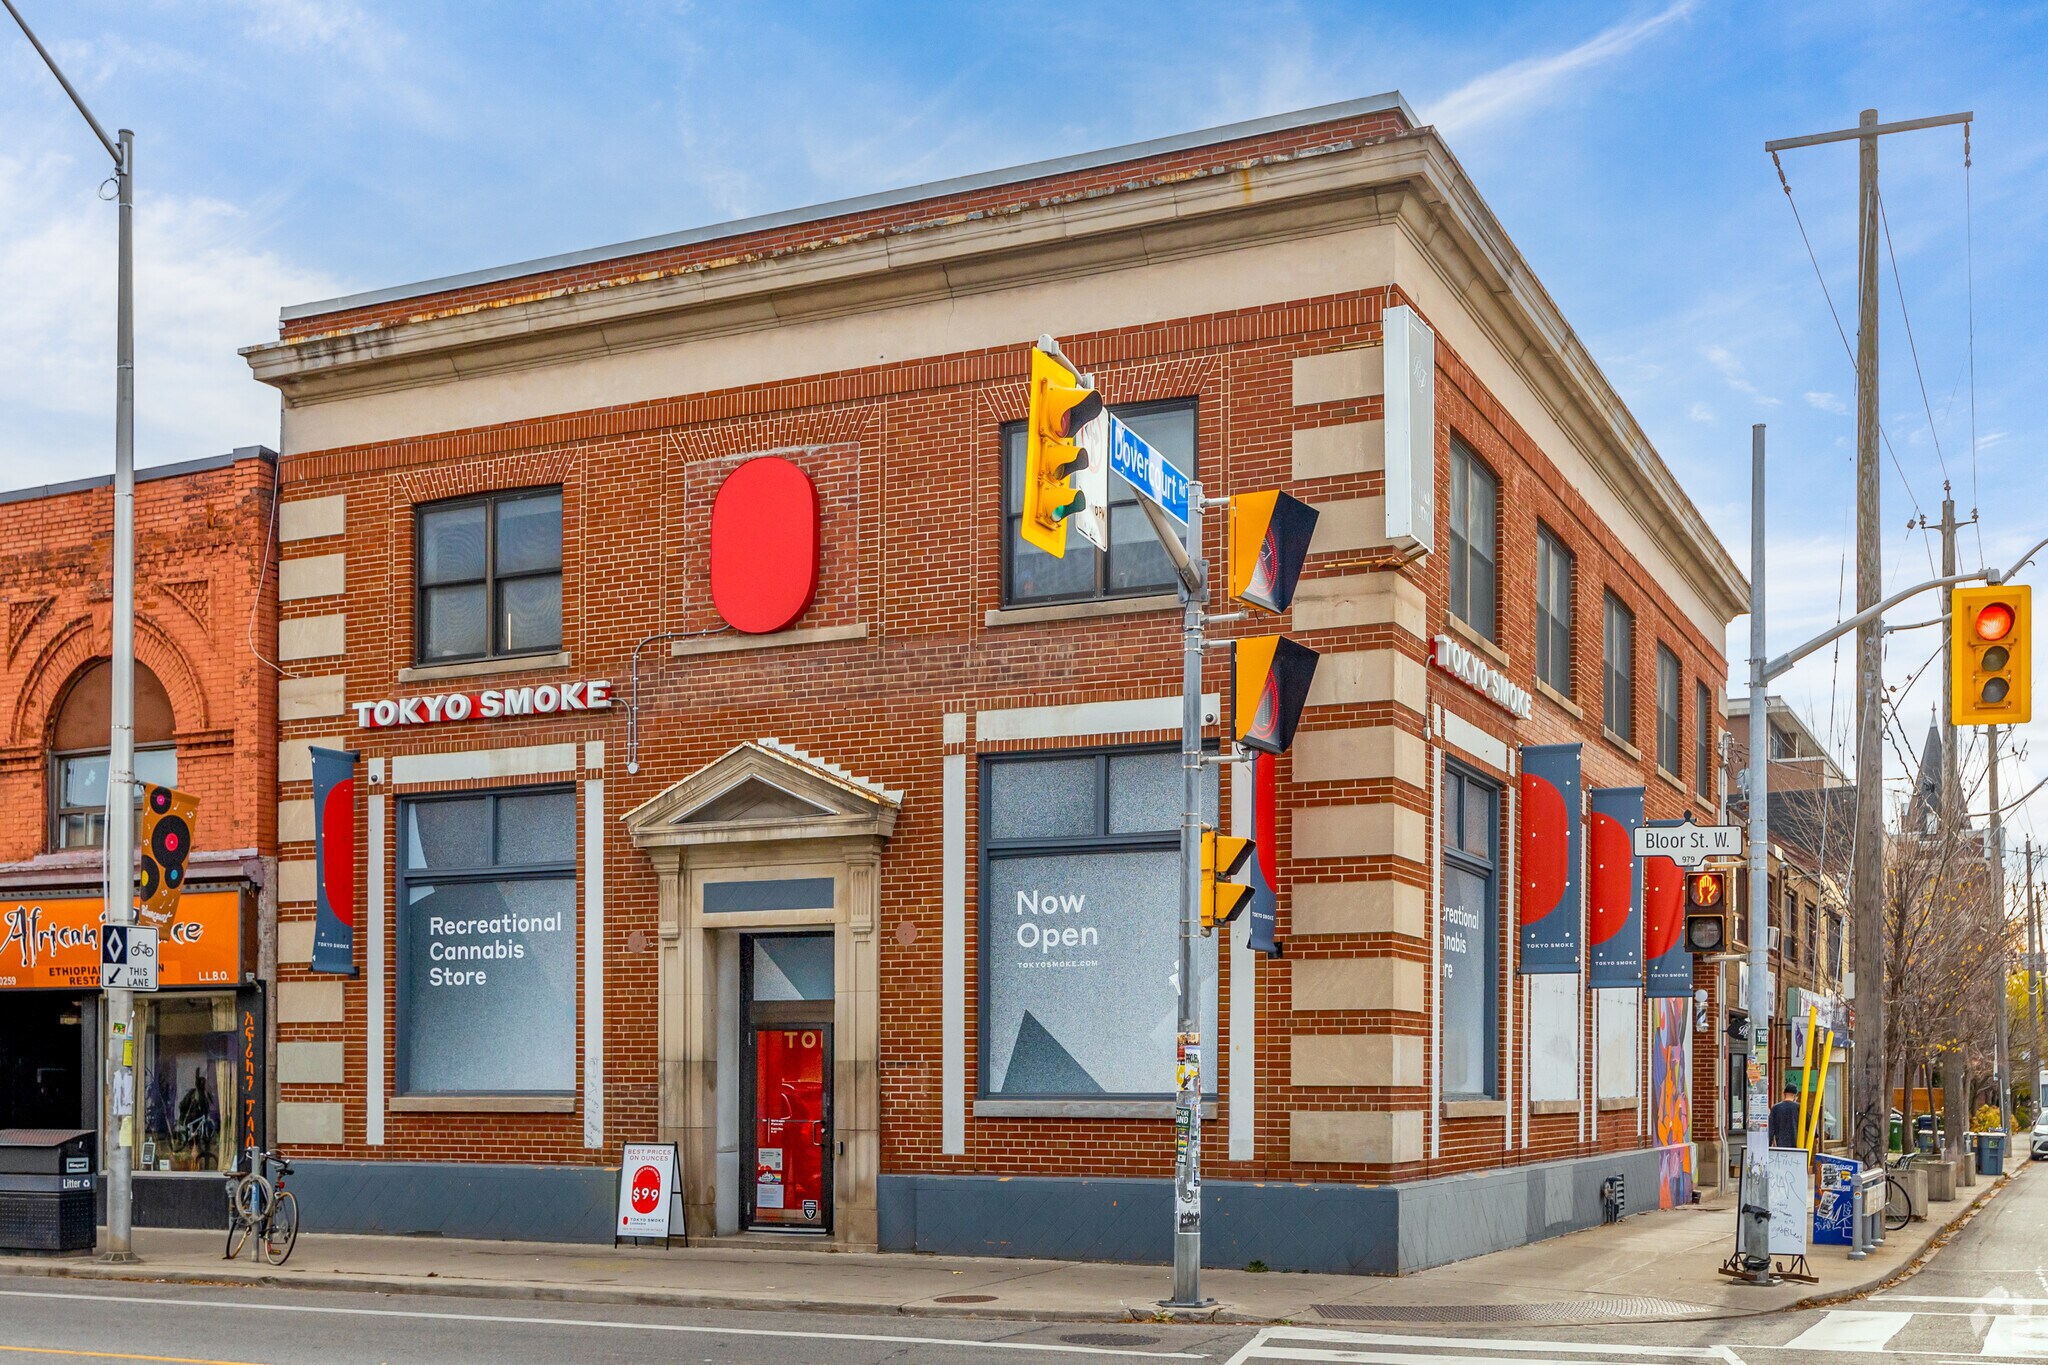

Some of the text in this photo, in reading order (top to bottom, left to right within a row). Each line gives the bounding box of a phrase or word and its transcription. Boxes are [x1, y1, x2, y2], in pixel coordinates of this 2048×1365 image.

[1115, 425, 1187, 505] Dovercourt Rd
[1434, 634, 1533, 721] TOKYO SMOKE
[352, 680, 612, 728] TOKYO SMOKE
[1645, 832, 1730, 849] Bloor St. W.
[1681, 855, 1696, 863] 979
[1017, 890, 1086, 915] Now
[430, 911, 562, 936] Recreational
[1443, 905, 1479, 930] reational
[0, 905, 98, 968] African
[1017, 922, 1098, 954] Open
[429, 939, 525, 961] Cannabis
[49, 966, 101, 976] ETHIOPIA
[129, 967, 148, 976] THIS
[1017, 960, 1098, 969] TOKYOSMOKE.COM
[127, 978, 149, 987] LANE
[198, 971, 230, 981] L.L.B.O.
[429, 967, 487, 987] Store
[784, 1031, 823, 1049] TO
[63, 1178, 81, 1189] Litter
[632, 1187, 659, 1203] $99
